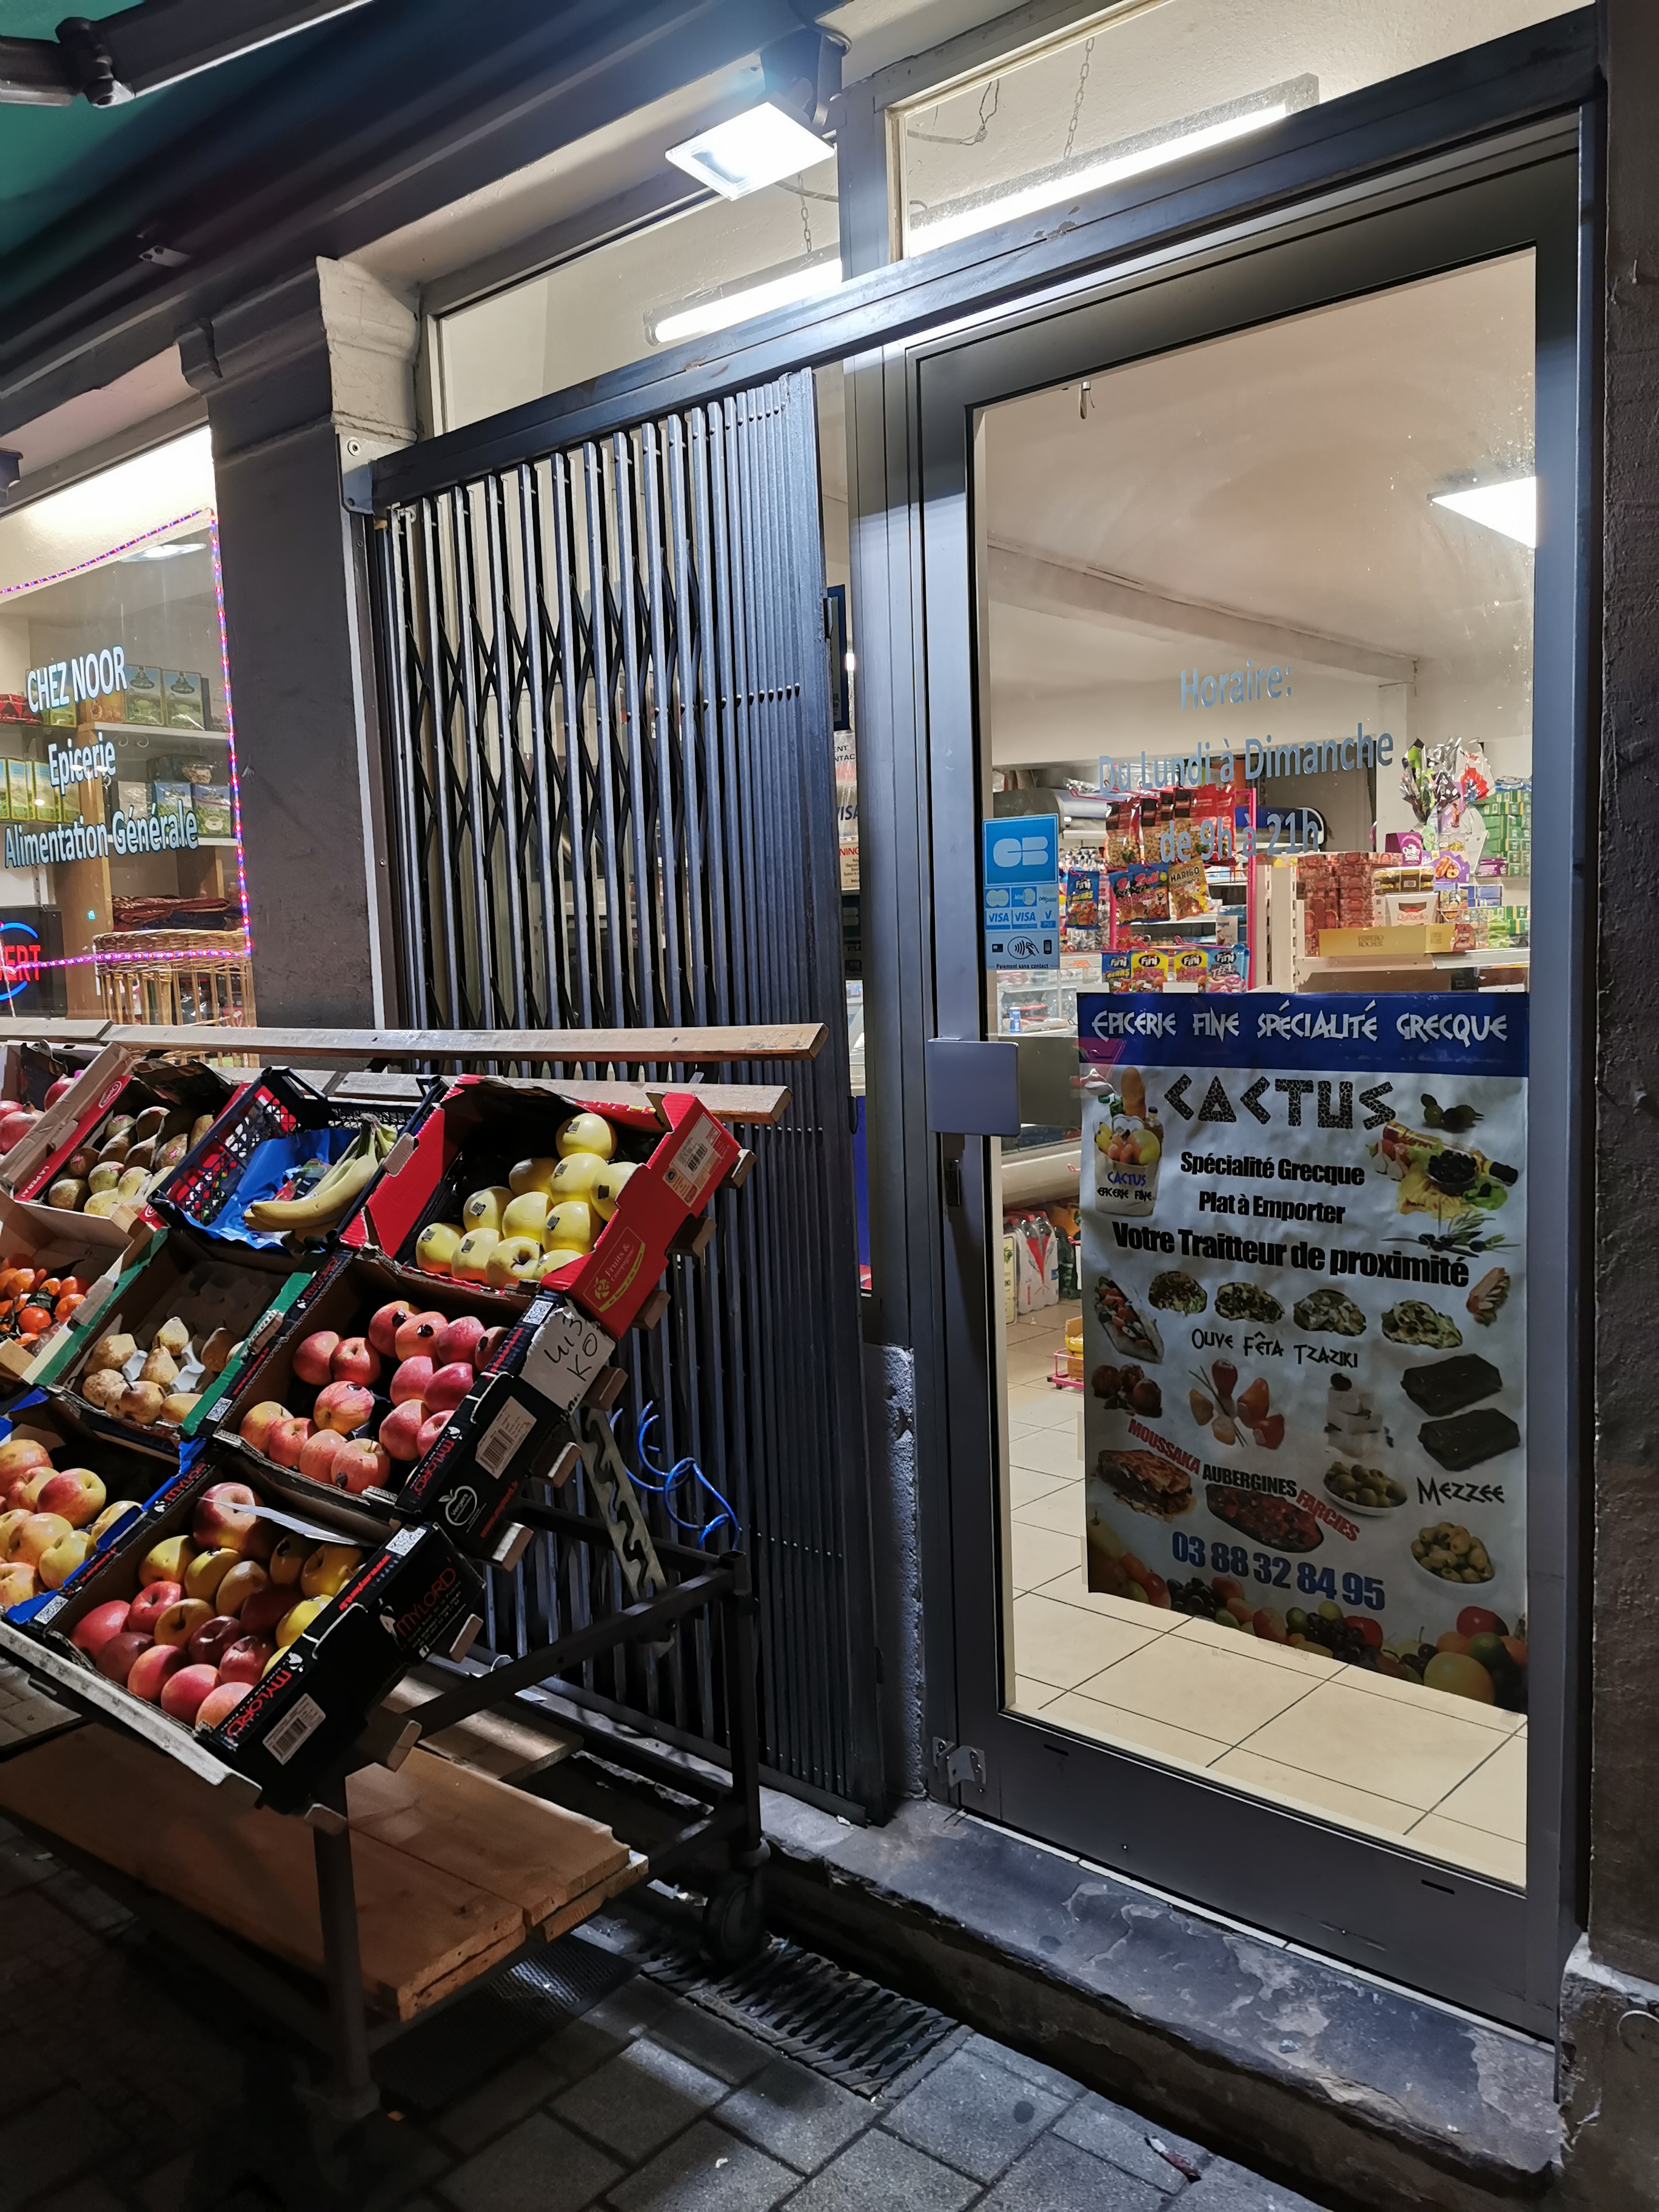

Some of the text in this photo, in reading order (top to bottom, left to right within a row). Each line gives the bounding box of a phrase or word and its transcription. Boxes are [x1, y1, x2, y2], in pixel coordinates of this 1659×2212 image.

[27, 646, 127, 714] CHEZ NOOR
[1180, 659, 1293, 709] Horaire:
[49, 732, 116, 794] Epicerie
[1098, 723, 1393, 794] Du Lundi à Dimanche
[5, 800, 198, 868] Alimentation Générale
[1160, 809, 1319, 863] de 9h à 21h
[1075, 878, 1091, 891] Fini
[1171, 867, 1199, 882] HARIBO
[989, 913, 1009, 922] VISA
[1015, 912, 1036, 922] VISA
[1045, 910, 1052, 919] V
[1110, 956, 1127, 968] Fini
[1141, 955, 1158, 967] Fini
[1184, 955, 1200, 967] Fini
[1216, 951, 1235, 964] Fini
[1092, 1000, 1508, 1047] EPICERIE FINE SPÉCIALITÉ GRECQUE
[1164, 1073, 1396, 1130] CACTUS
[1107, 1171, 1146, 1187] CACTUS
[1181, 1151, 1365, 1186] Spécialité Grecque
[1097, 1187, 1152, 1202] EPICERIE FINE
[1199, 1191, 1346, 1225] Plat à Emporter
[603, 1250, 627, 1277] Fruits
[1111, 1221, 1469, 1289] Votre Traitteur de proximité
[1191, 1328, 1233, 1350] OLIVE
[1293, 1343, 1359, 1369] TZAZIKI
[414, 1439, 455, 1495] MYLORD
[1127, 1419, 1360, 1542] MOUSSAKA AUBERGINES FARCIES
[1416, 1476, 1505, 1507] MEZZEE
[1172, 1531, 1385, 1611] 03 88 32 84 95
[396, 1568, 456, 1634] MYLORD
[226, 1669, 293, 1737] MYLORD
